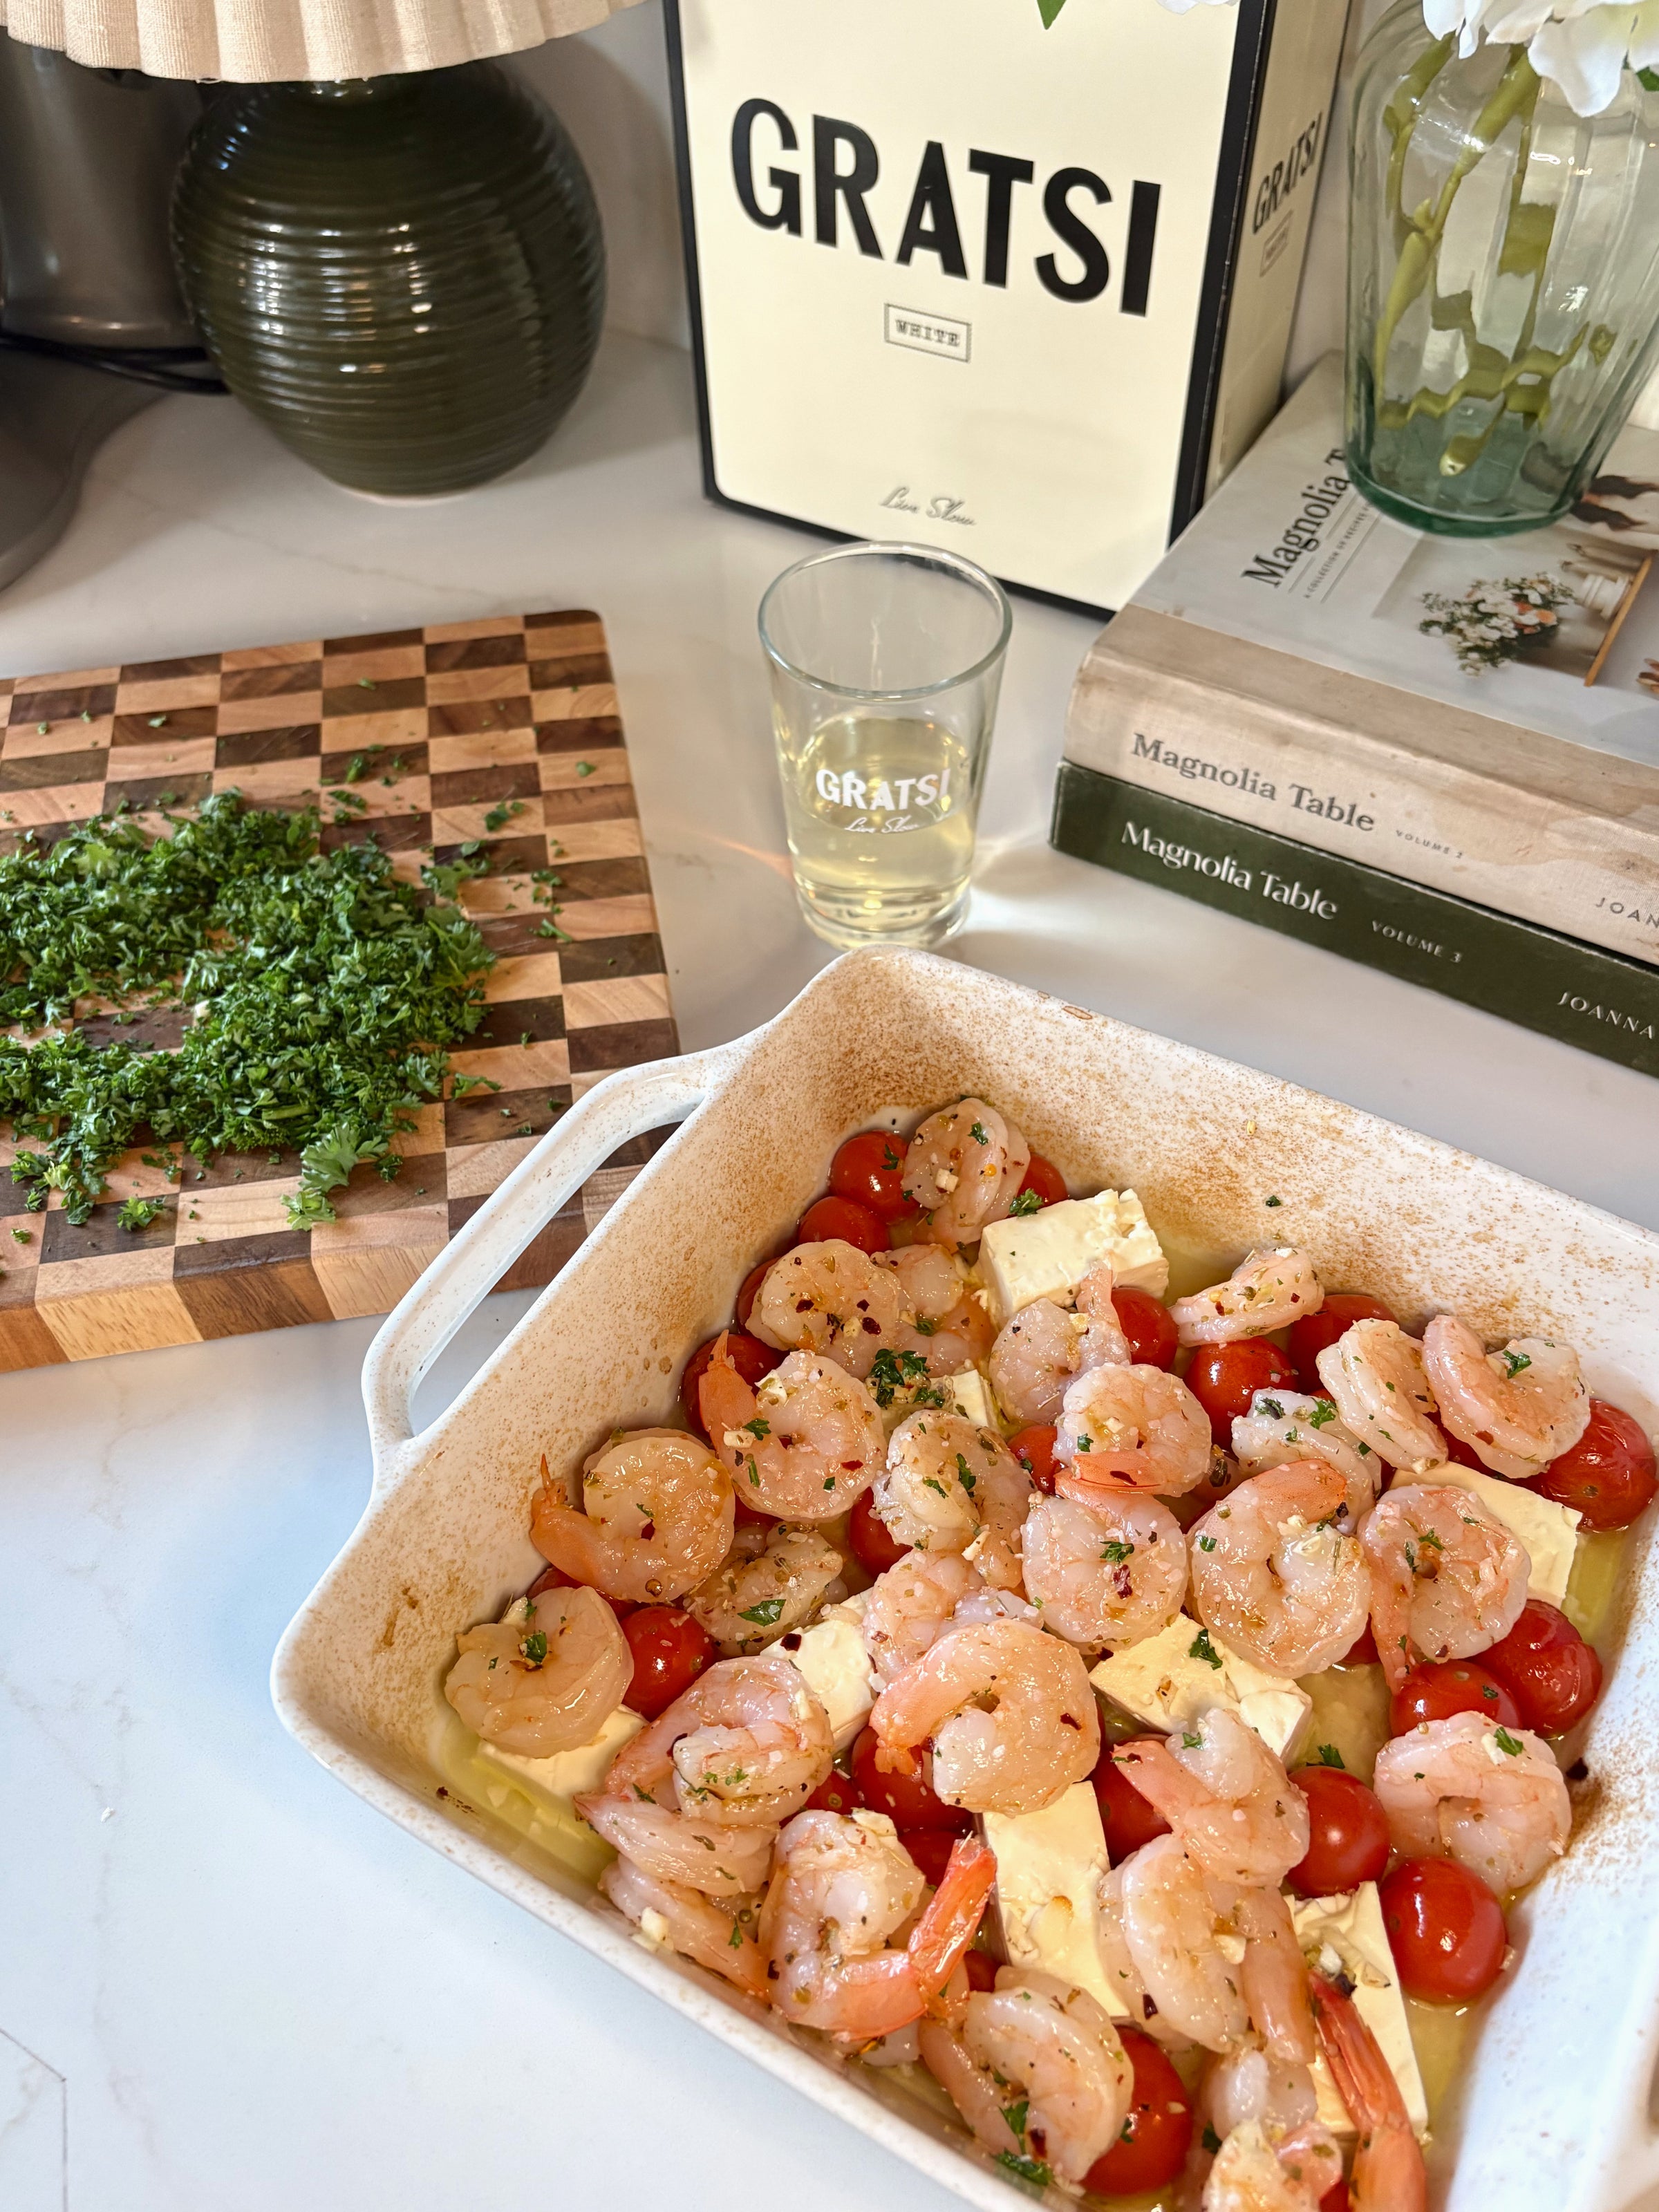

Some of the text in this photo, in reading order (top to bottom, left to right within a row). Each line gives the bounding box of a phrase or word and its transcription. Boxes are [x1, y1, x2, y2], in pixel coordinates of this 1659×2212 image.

[731, 97, 1162, 318] GRATSI
[1253, 112, 1322, 235] GRATSI
[894, 319, 960, 347] WHITE
[1241, 476, 1350, 588] Magnolia
[816, 768, 951, 811] GRATSI
[1130, 733, 1463, 859] Magnolia Table VOLUME 2
[1121, 821, 1463, 964] Magnolia Table VOLUME 3
[1557, 991, 1655, 1040] JOANNA
